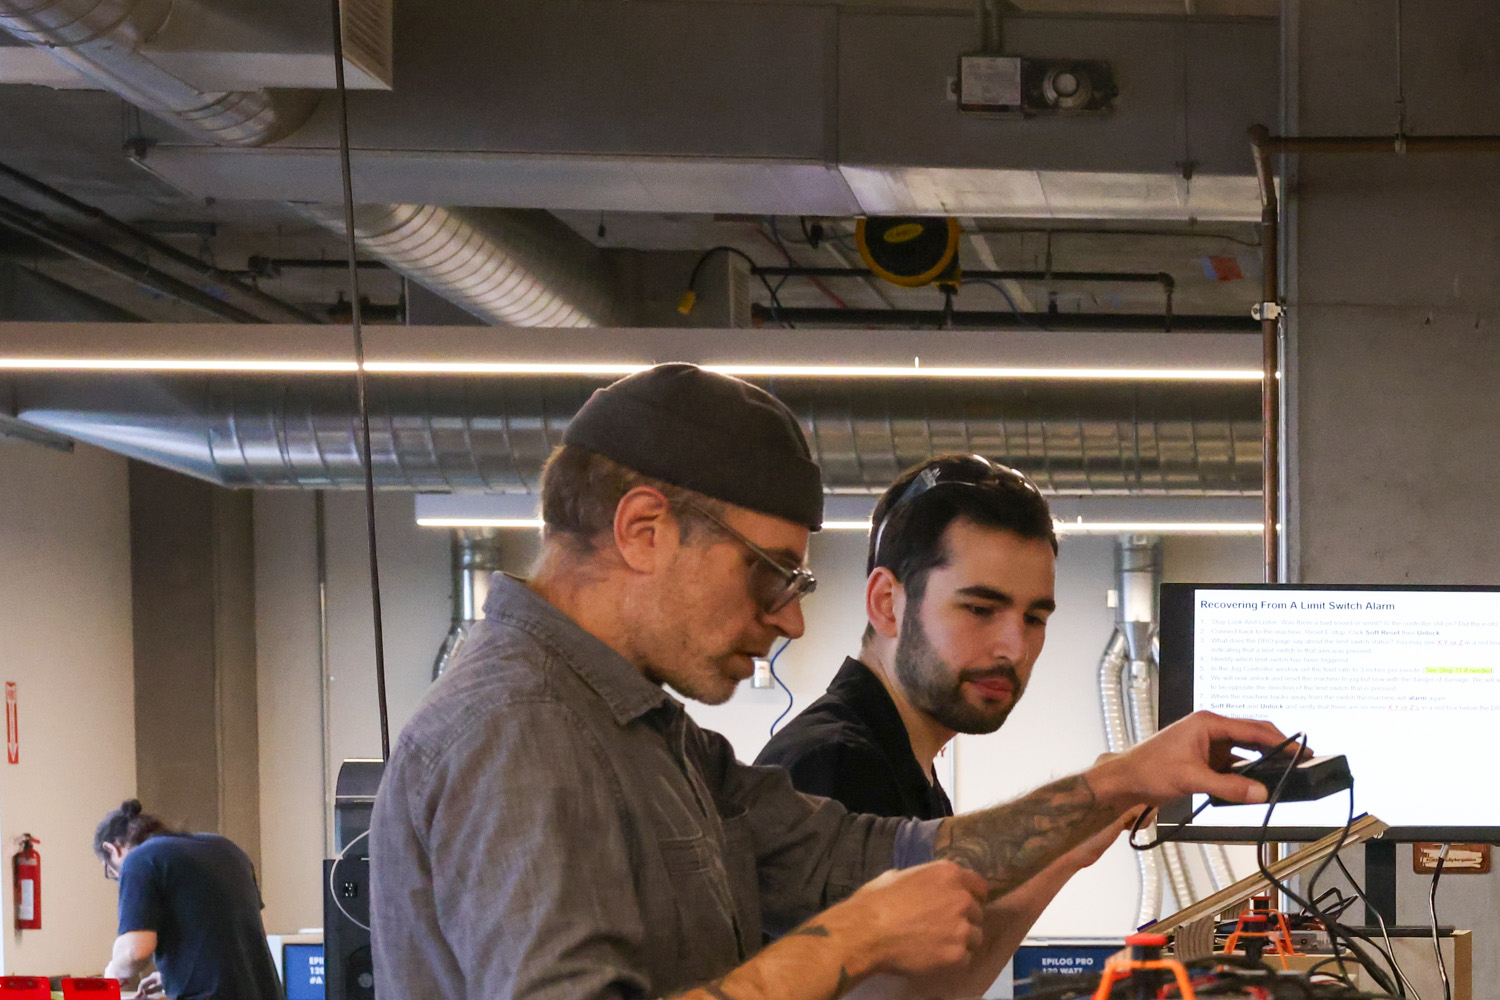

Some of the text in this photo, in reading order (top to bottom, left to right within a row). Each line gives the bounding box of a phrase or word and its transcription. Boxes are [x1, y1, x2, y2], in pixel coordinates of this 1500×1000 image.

[1200, 600, 1395, 611] Recovering From A Limit Switch Alarm
[1041, 957, 1094, 966] EPILOG PRO
